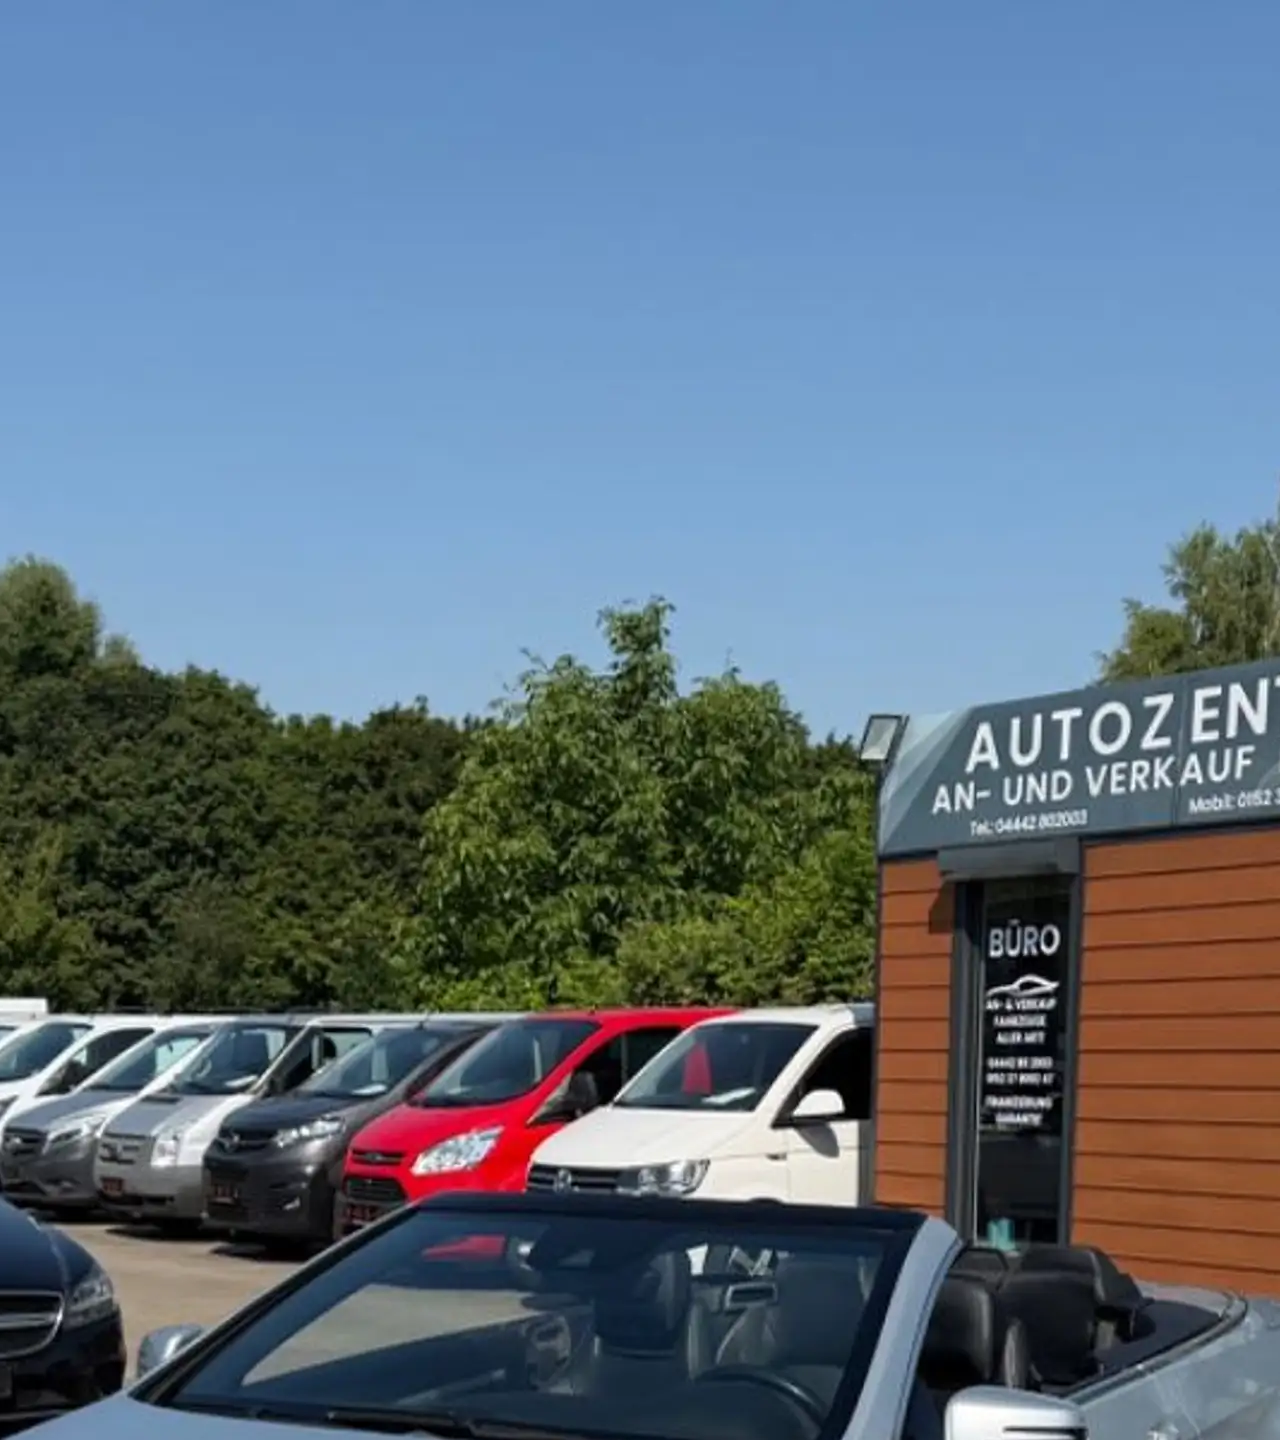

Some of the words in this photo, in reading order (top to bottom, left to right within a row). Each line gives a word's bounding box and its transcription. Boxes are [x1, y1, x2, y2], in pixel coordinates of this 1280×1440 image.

[931, 780, 991, 815] AN-
[1003, 770, 1073, 806] UND
[1085, 745, 1255, 798] VERKAUF
[988, 918, 1061, 958] BÜRO
